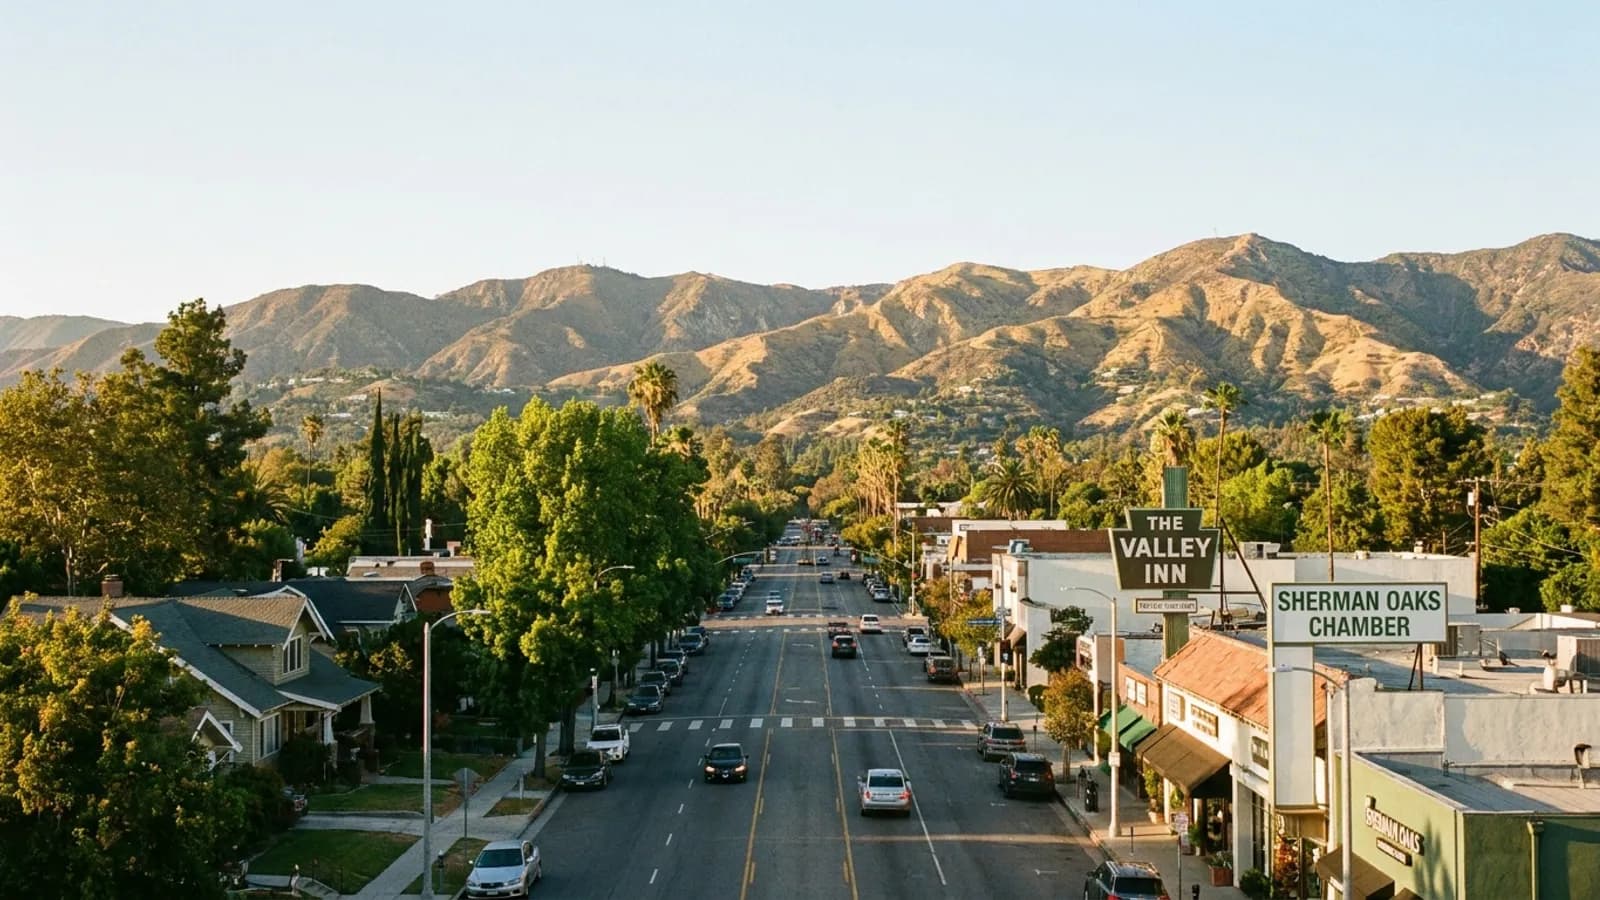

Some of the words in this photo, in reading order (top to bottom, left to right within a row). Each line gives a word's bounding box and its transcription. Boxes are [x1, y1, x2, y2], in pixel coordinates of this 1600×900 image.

[1147, 516, 1184, 531] THE
[1120, 538, 1211, 558] VALLEY
[1145, 564, 1186, 584] INN
[1278, 590, 1379, 612] SHERMAN
[1386, 590, 1441, 611] OAKS
[1309, 616, 1410, 637] CHAMBER
